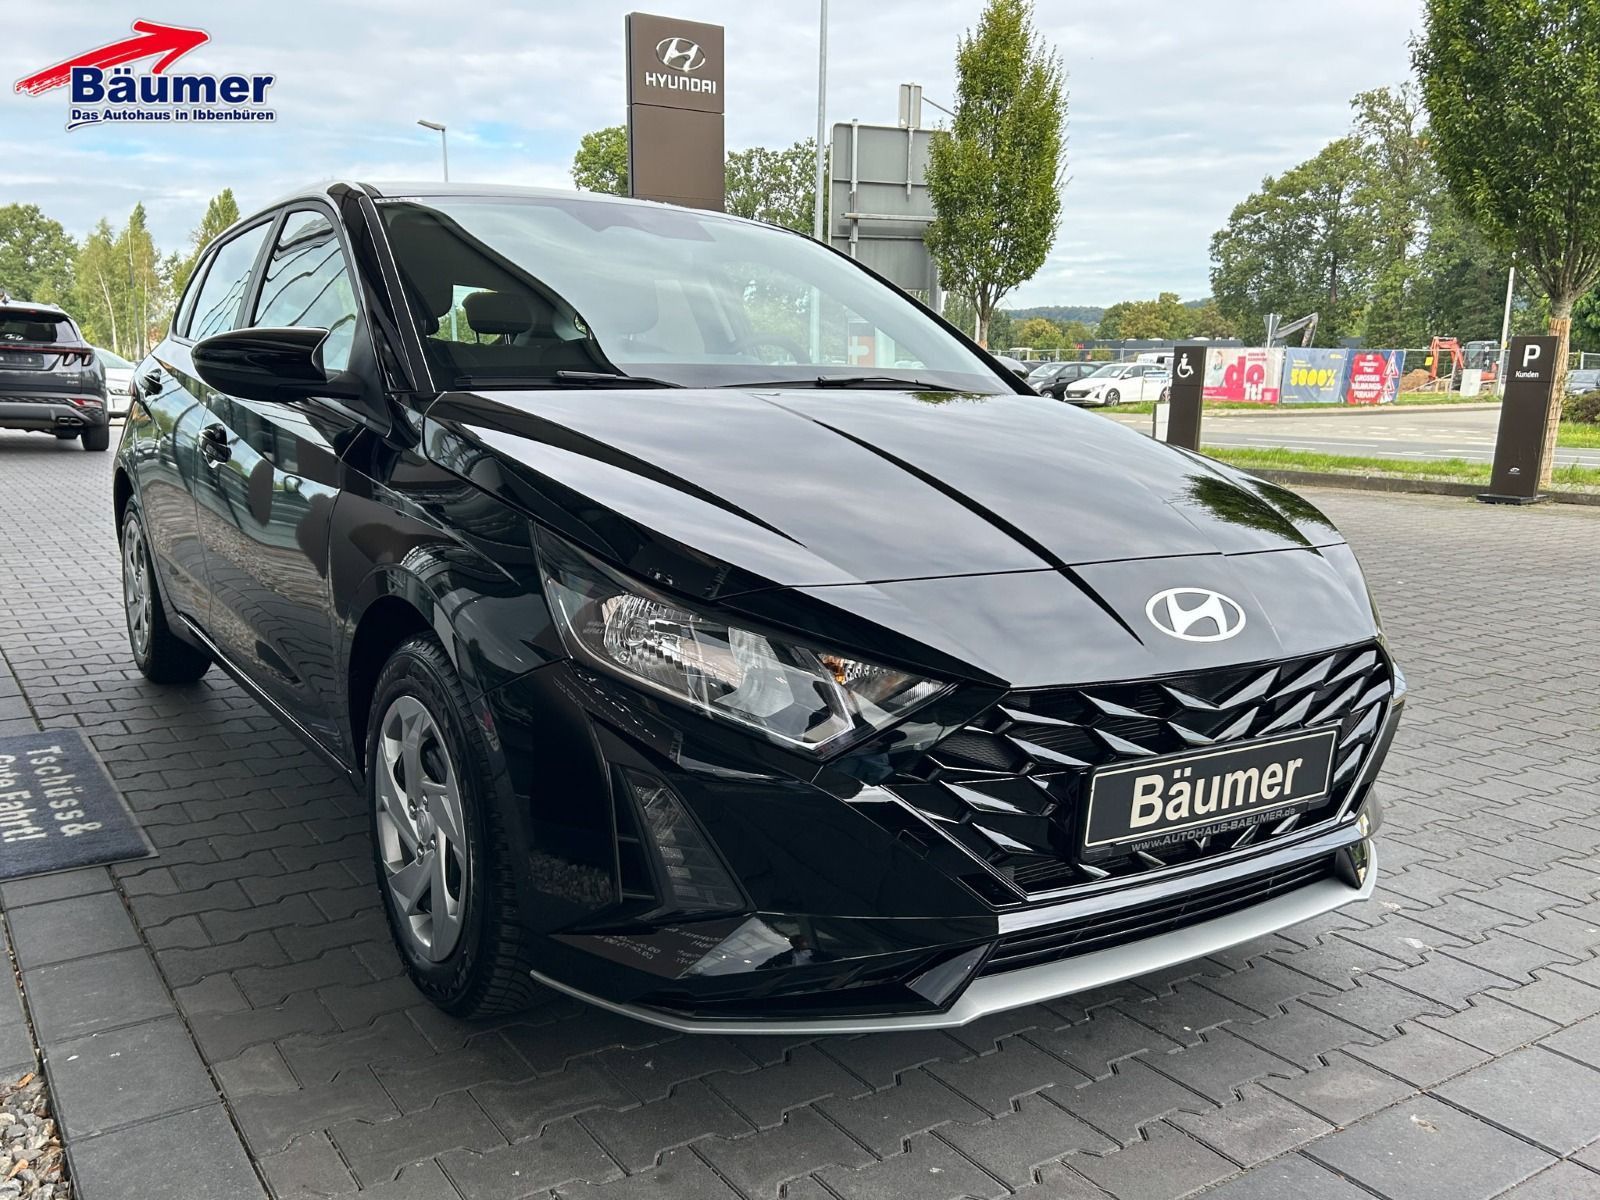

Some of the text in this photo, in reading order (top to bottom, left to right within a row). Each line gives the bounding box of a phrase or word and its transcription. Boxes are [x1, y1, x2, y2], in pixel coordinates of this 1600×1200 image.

[645, 71, 717, 95] HYUNDAI
[1515, 370, 1540, 379] Kunden
[1522, 344, 1541, 368] P
[26, 745, 102, 837] Tschüss &
[1129, 757, 1303, 829] Bäumer
[0, 789, 48, 843] Fahrt!
